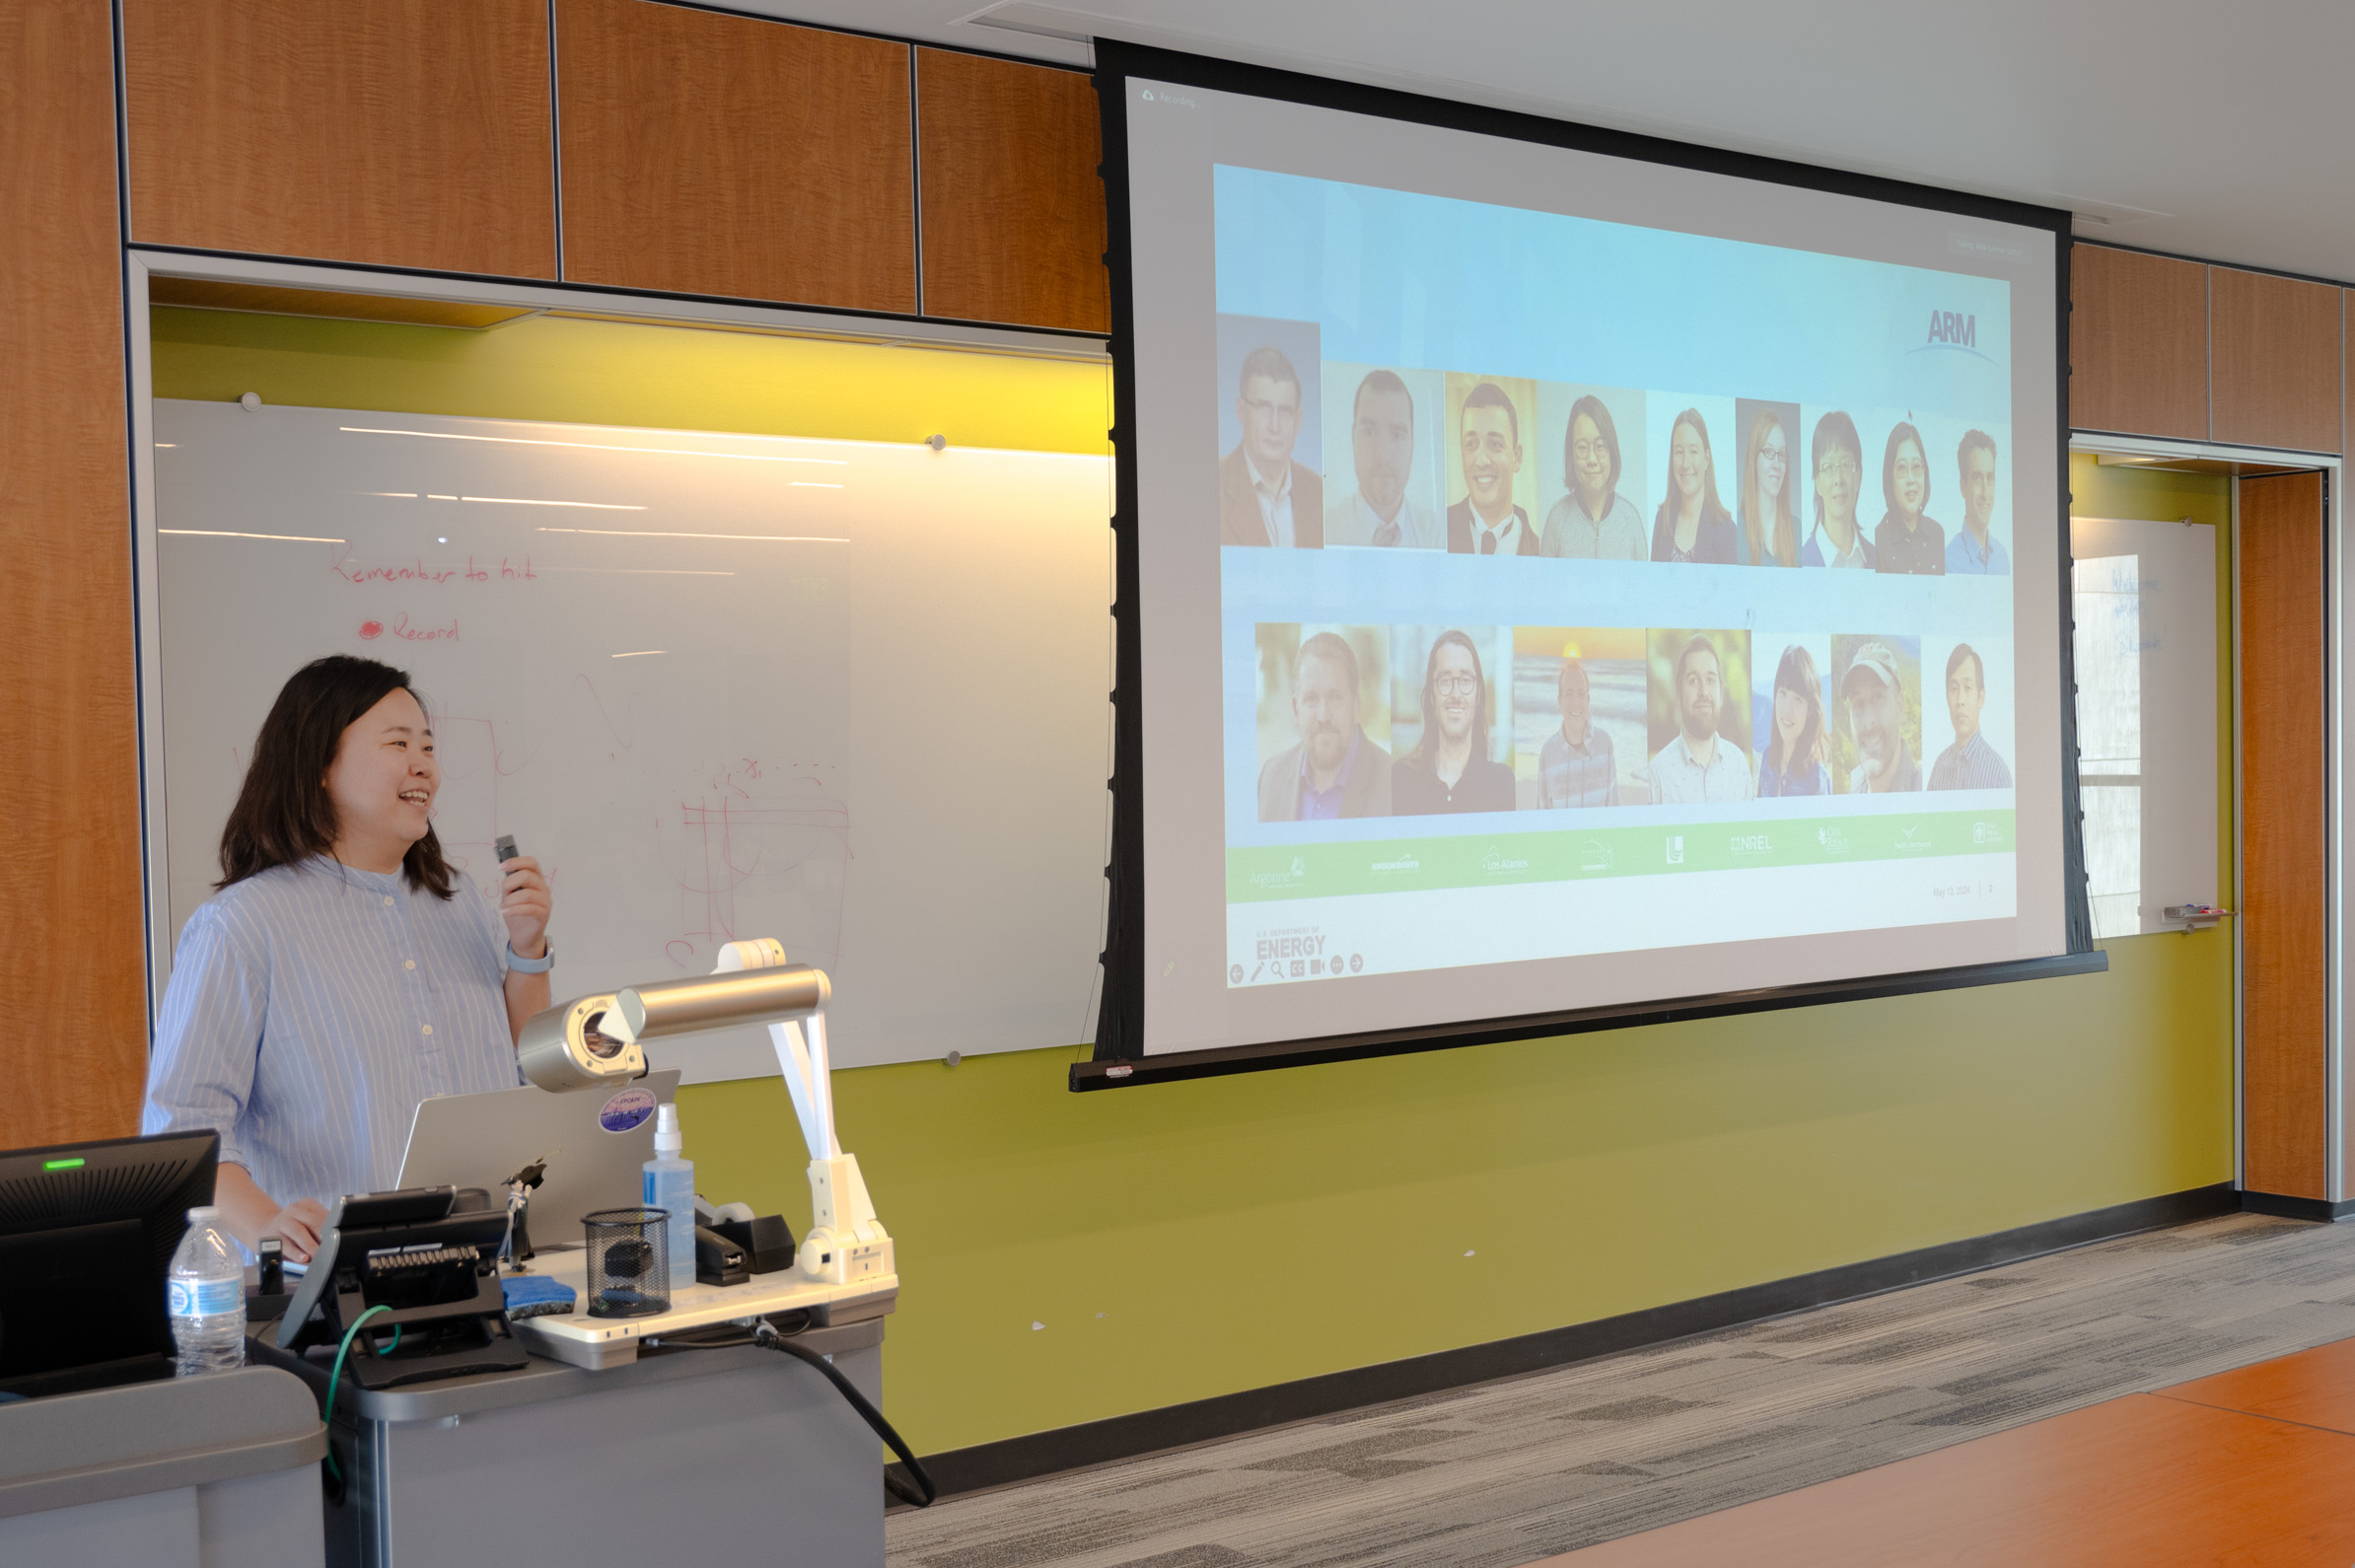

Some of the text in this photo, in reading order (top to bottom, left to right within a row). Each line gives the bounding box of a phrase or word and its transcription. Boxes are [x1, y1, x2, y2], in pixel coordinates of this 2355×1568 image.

[1927, 310, 1975, 348] ARM
[330, 538, 536, 584] Remember to hit
[392, 610, 461, 643] Record
[1742, 835, 1774, 852] NREL
[1487, 858, 1530, 870] Los Alamos
[1249, 868, 1291, 890] Argonne
[1269, 928, 1310, 937] DEPARTMENT
[1256, 935, 1325, 961] ENERGY
